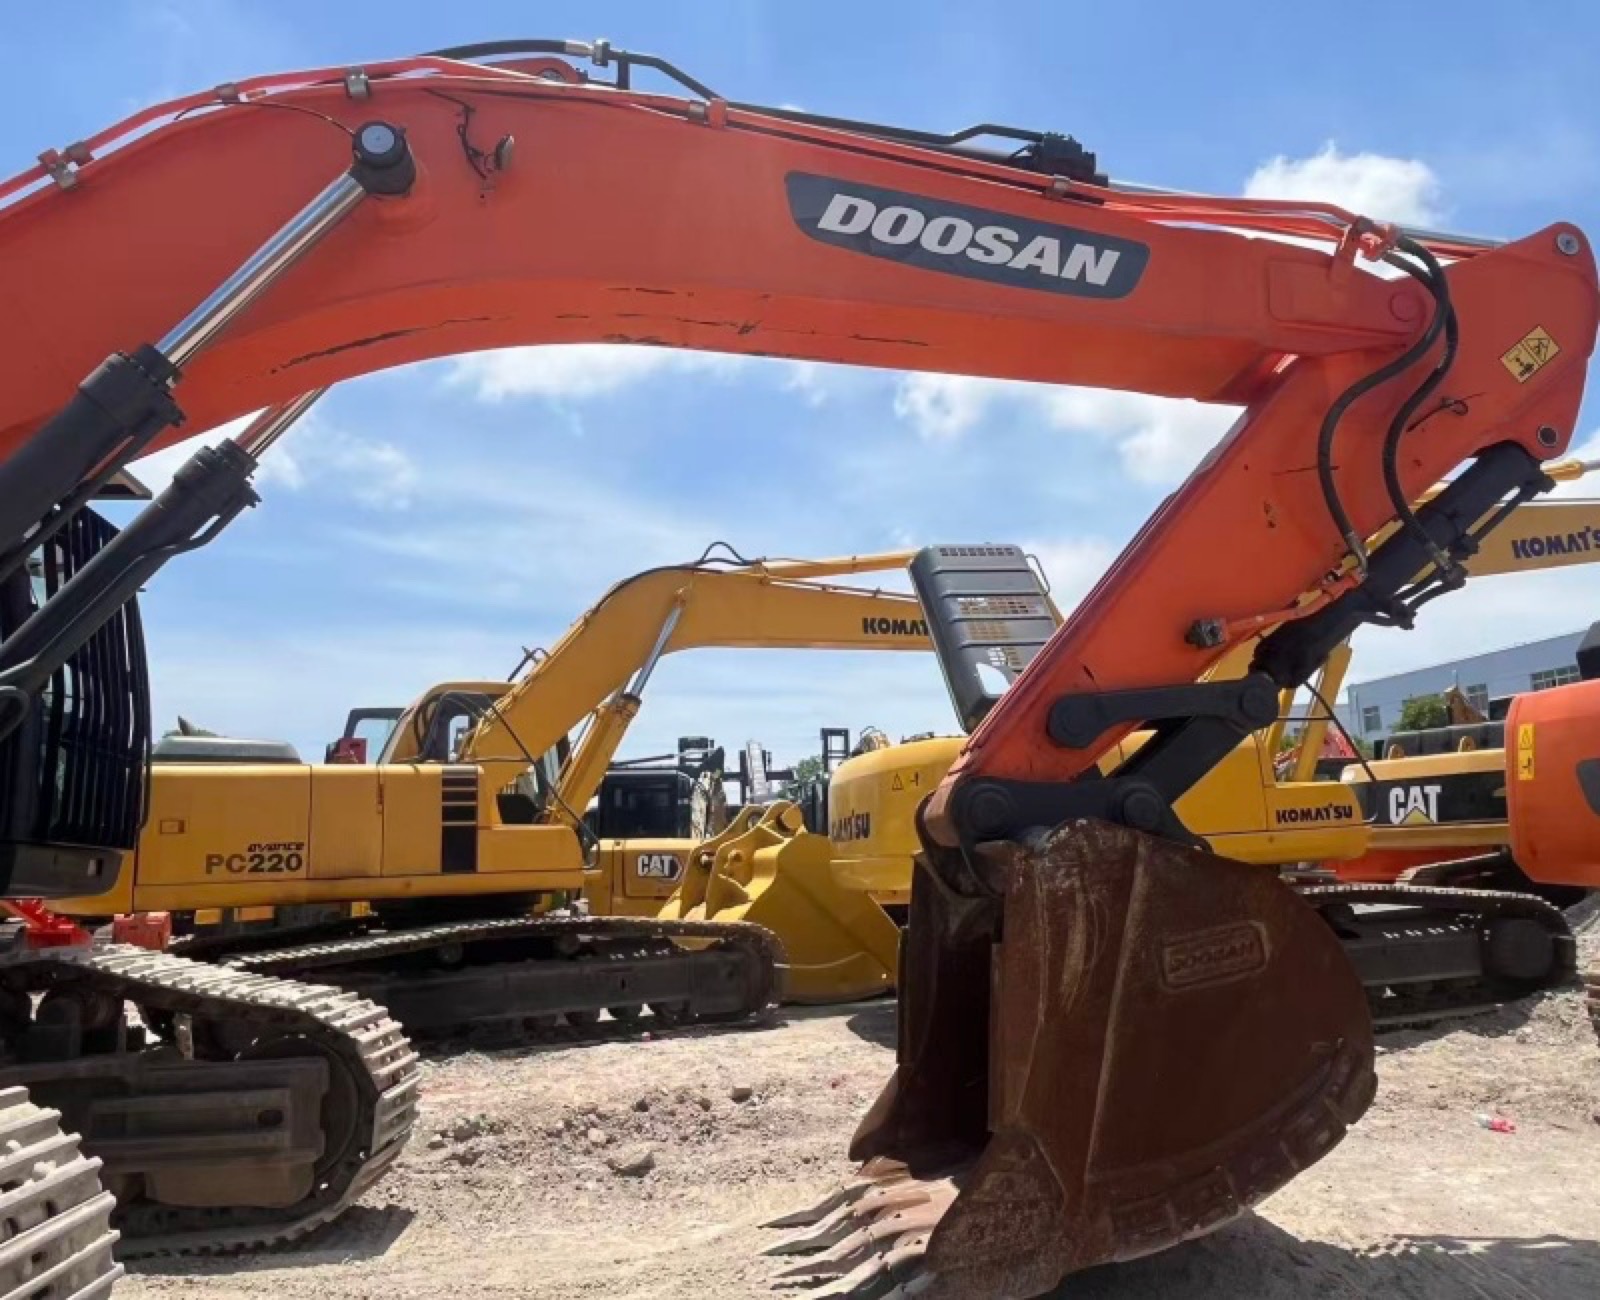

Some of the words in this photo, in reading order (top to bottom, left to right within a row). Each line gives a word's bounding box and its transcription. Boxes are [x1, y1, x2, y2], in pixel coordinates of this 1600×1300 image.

[817, 193, 1119, 286] DOOSAN
[1276, 803, 1352, 824] KOMATSU
[1388, 784, 1442, 825] CAT
[205, 853, 303, 875] PC220
[637, 855, 673, 877] CAT
